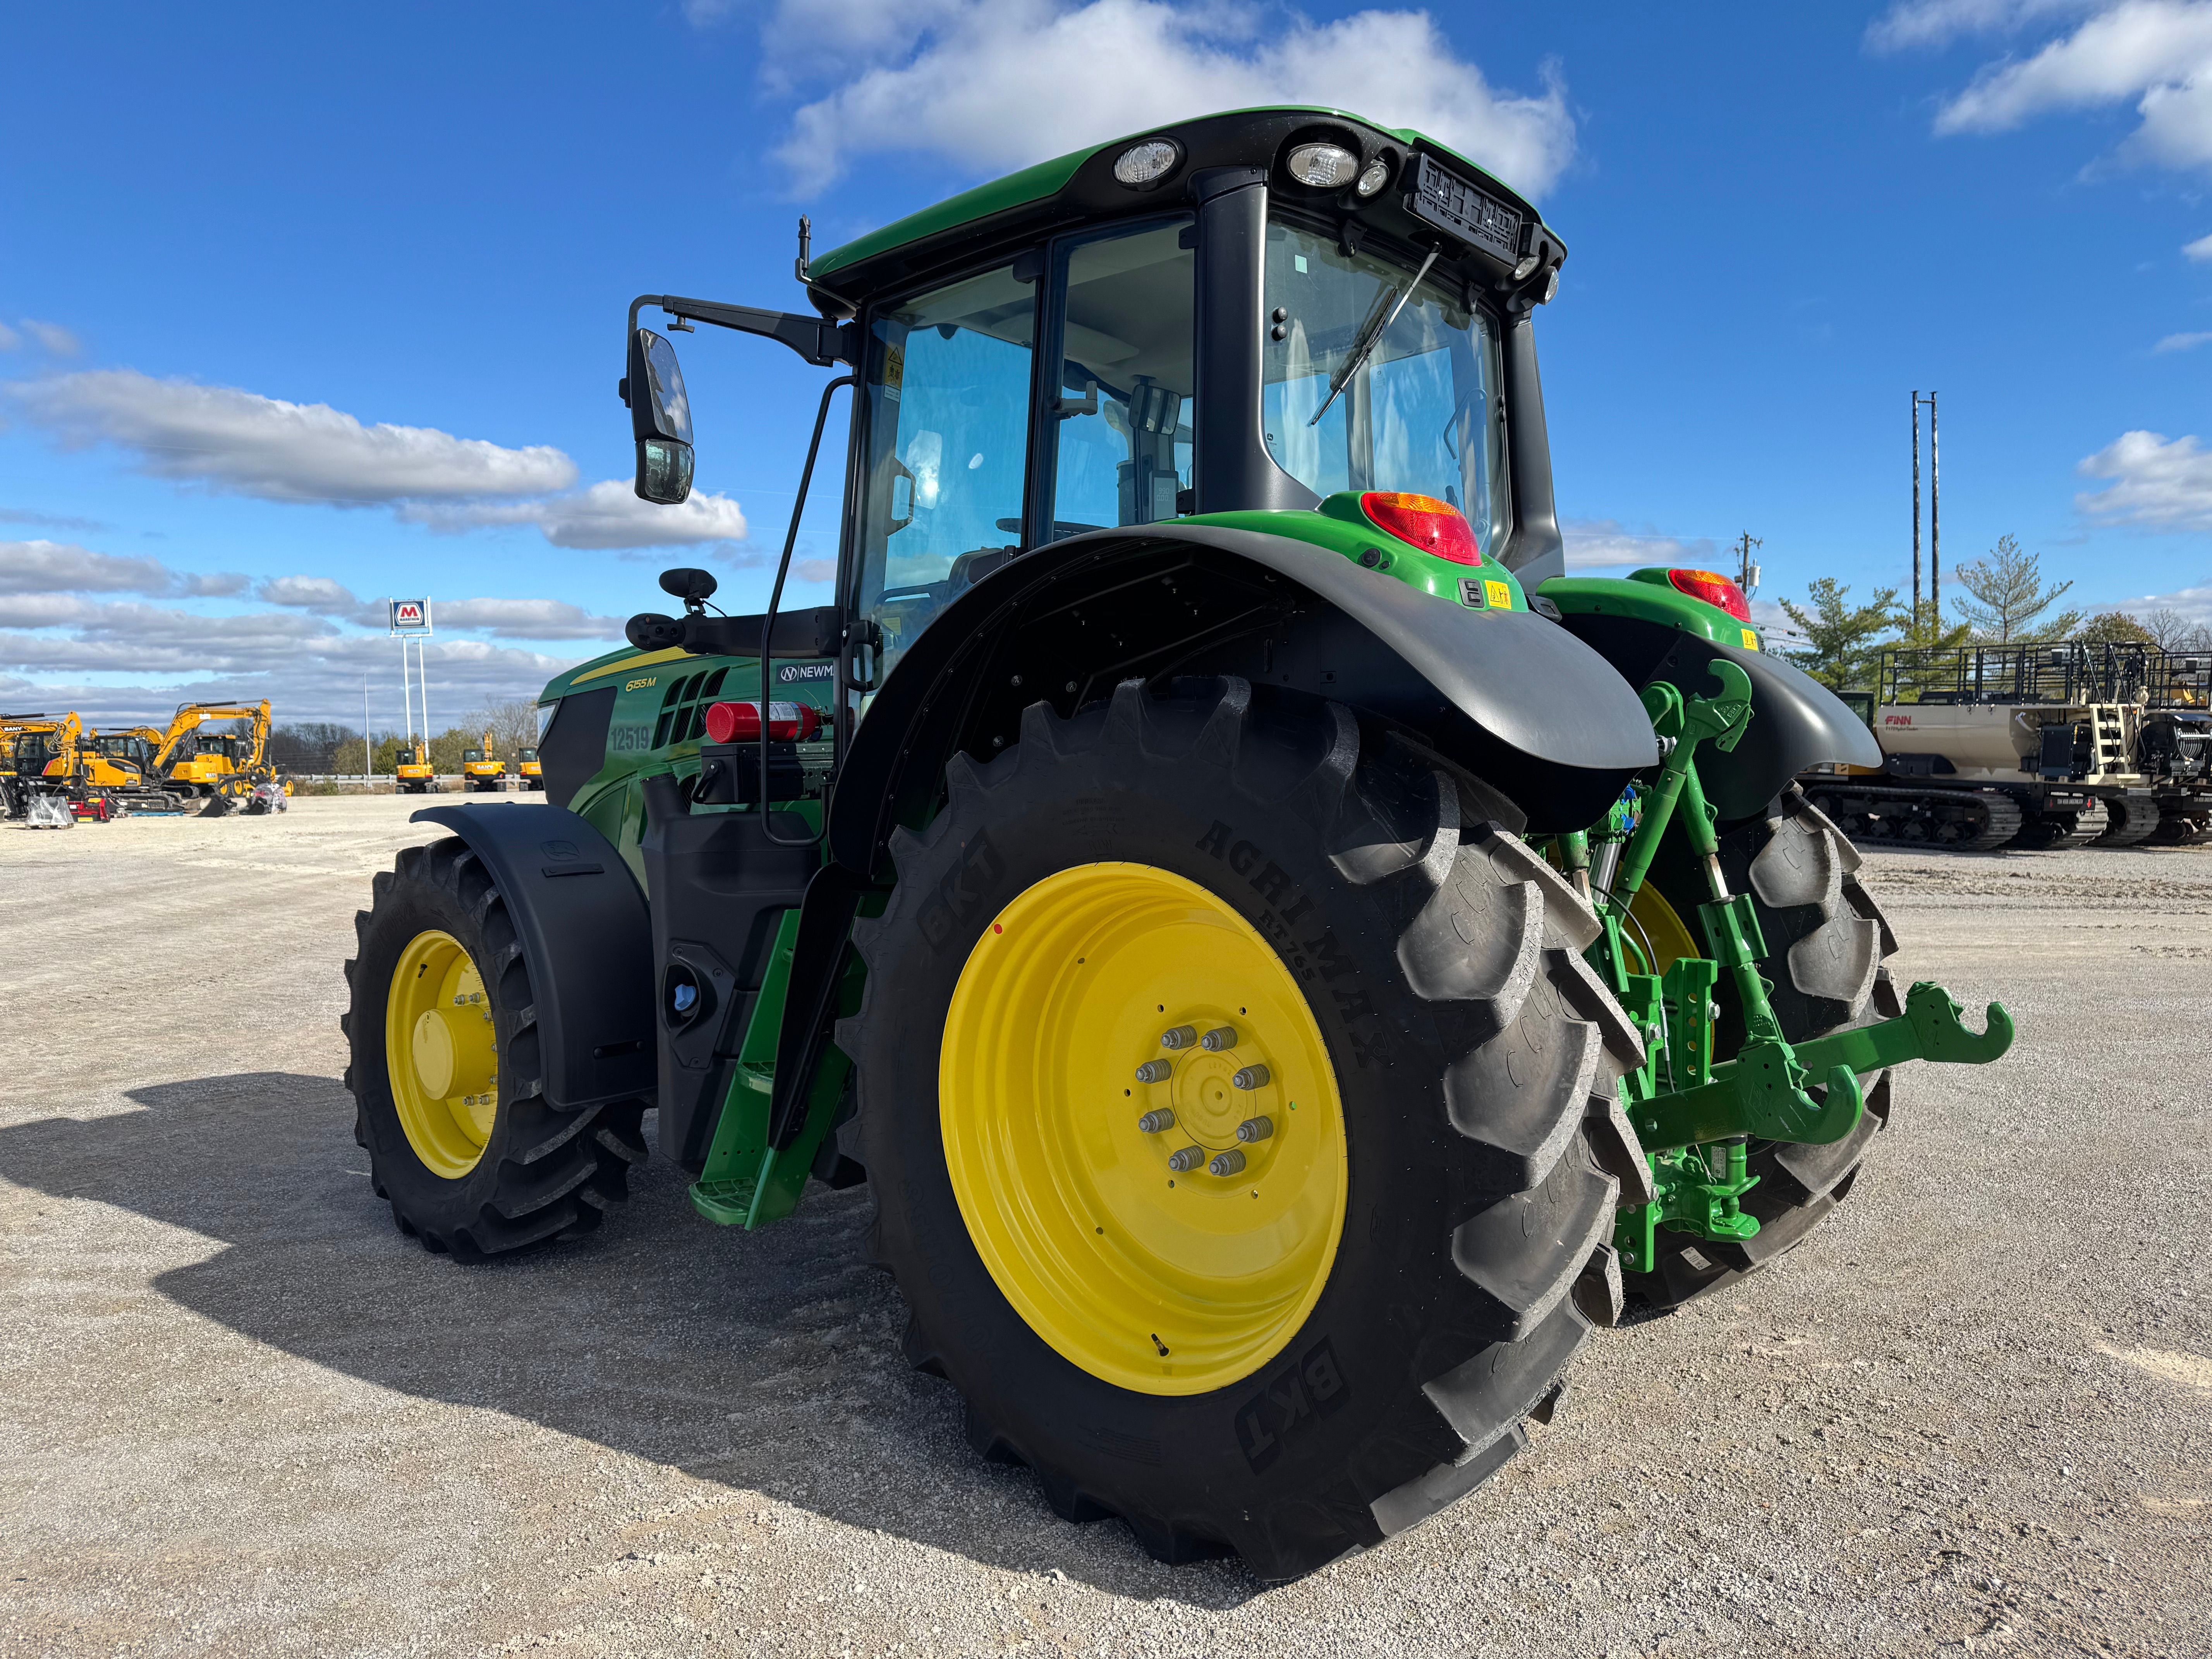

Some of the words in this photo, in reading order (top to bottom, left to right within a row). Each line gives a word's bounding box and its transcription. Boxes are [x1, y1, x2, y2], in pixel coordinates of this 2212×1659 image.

[400, 607, 418, 617] M
[800, 665, 834, 678] NEWM
[1884, 715, 1911, 725] FINN
[611, 726, 649, 750] 12519
[921, 839, 996, 946] BKT
[1195, 819, 1317, 926] AGRI
[1303, 931, 1394, 1069] MAX
[1245, 1349, 1344, 1460] BKT
